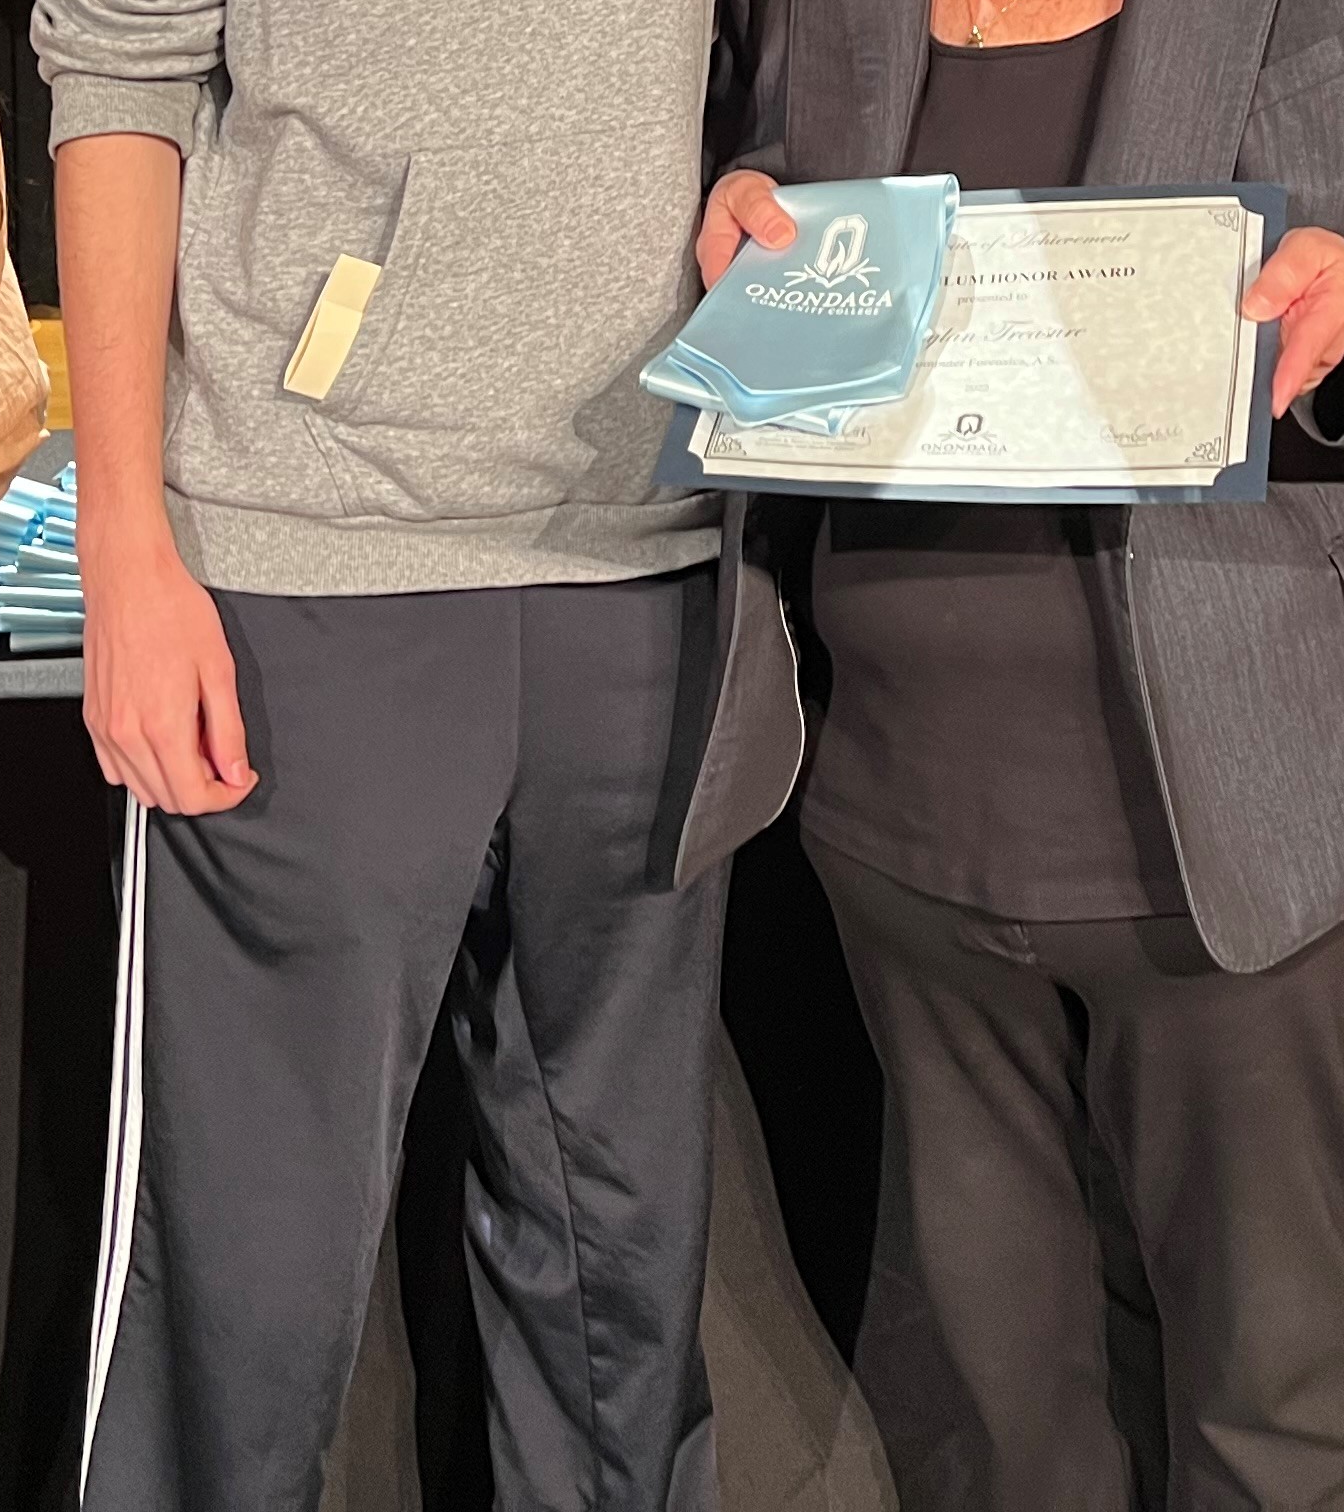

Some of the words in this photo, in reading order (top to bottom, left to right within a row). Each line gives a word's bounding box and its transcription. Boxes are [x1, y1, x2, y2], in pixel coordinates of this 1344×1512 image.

[991, 270, 1058, 285] HONOR
[1065, 266, 1136, 281] AWARD
[745, 283, 893, 308] ONONDAGA
